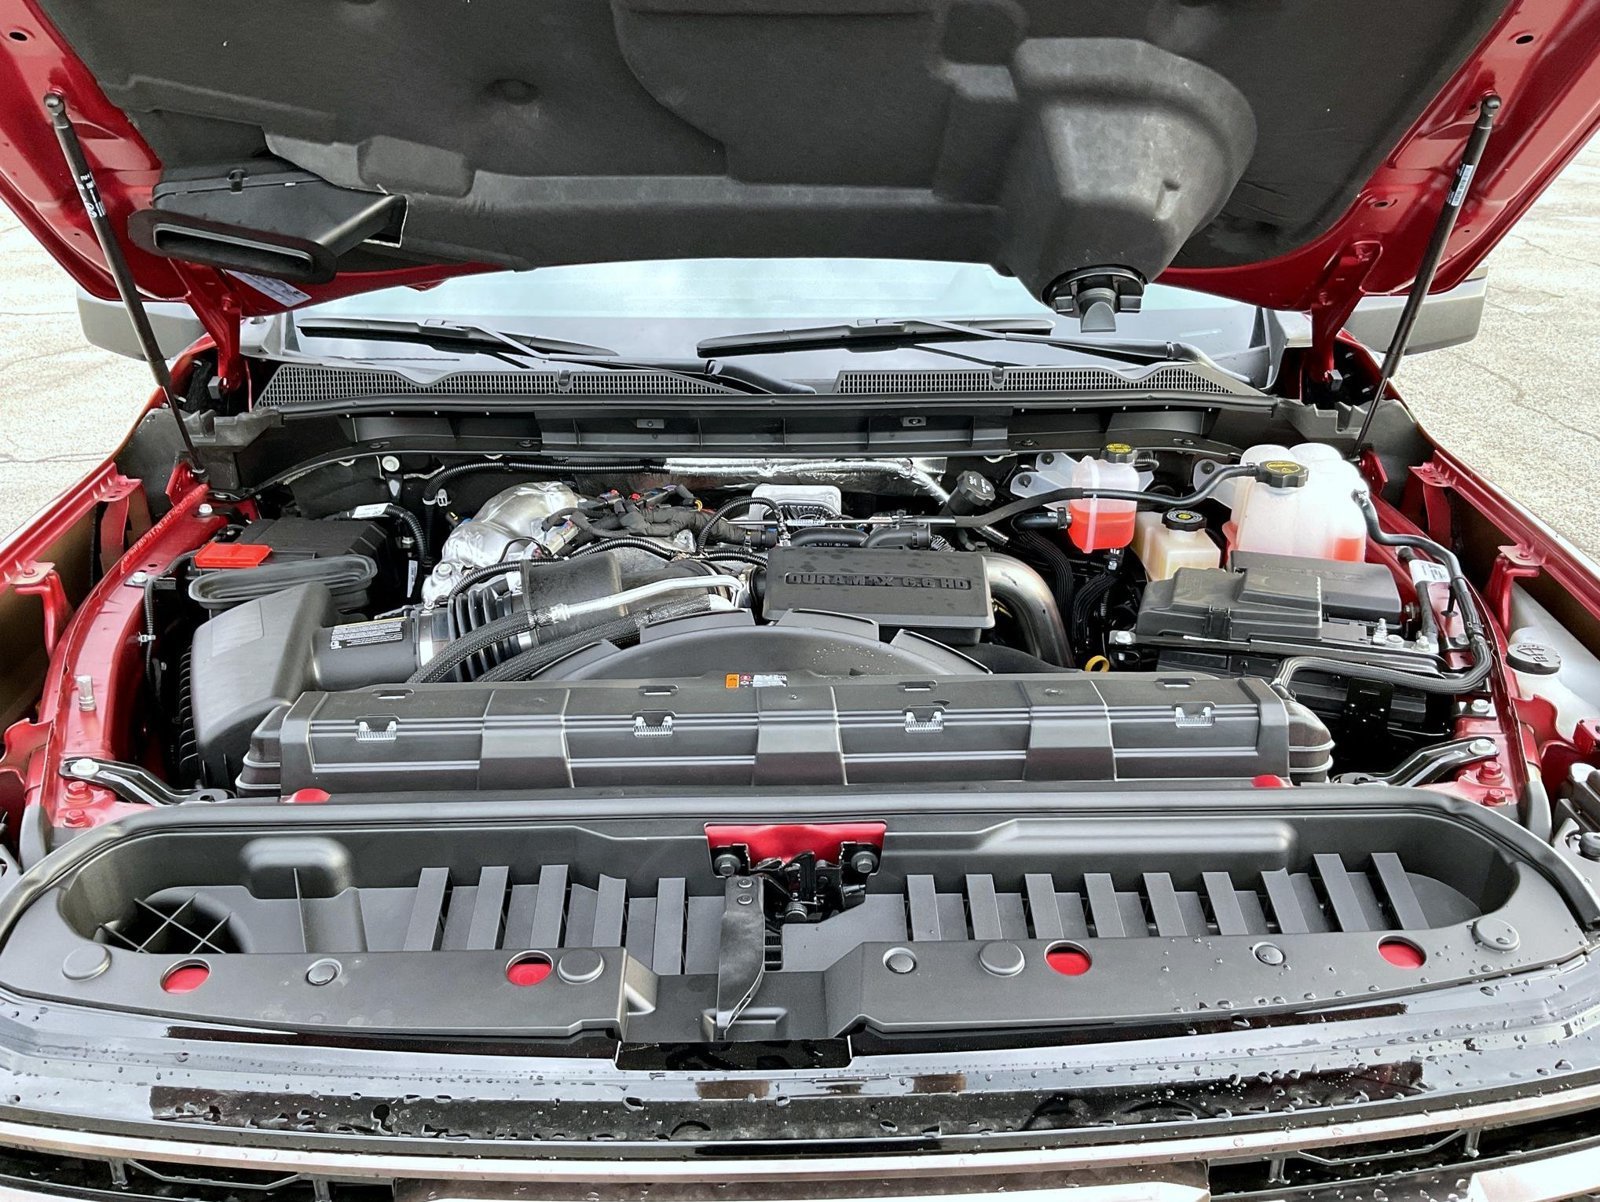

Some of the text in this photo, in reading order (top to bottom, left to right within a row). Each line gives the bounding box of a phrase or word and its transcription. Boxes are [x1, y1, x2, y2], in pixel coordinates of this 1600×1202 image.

[788, 573, 971, 590] DURAMAX 6.6 HD
